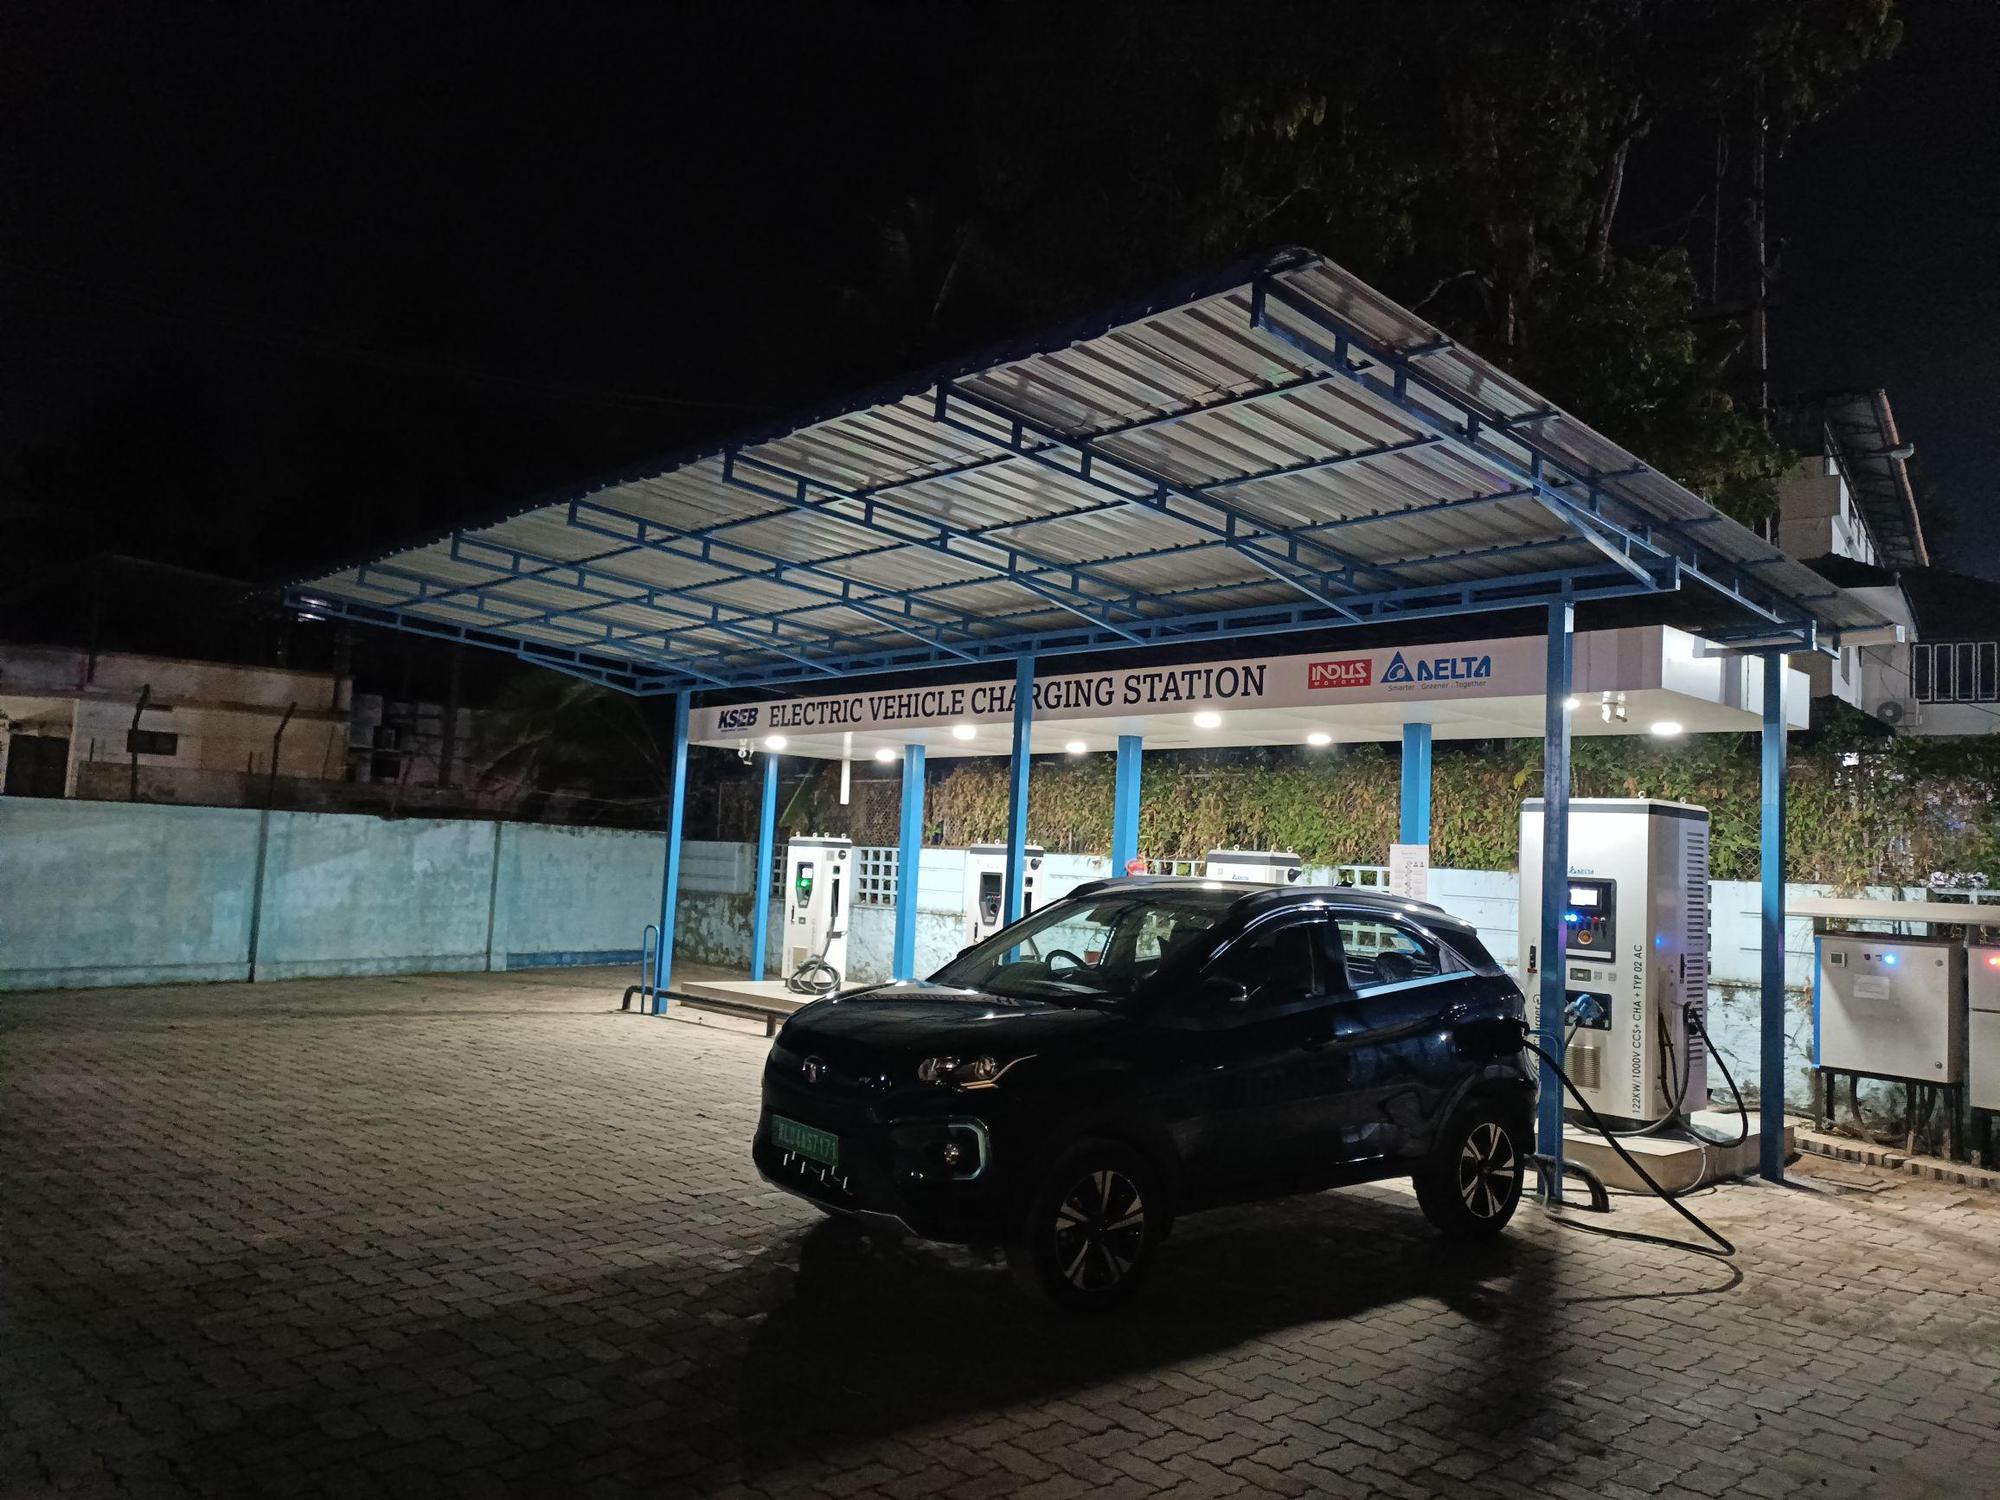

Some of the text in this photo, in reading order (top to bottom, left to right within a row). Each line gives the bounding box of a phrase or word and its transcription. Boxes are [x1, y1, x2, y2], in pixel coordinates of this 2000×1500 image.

[1311, 662, 1367, 680] INDUS
[1417, 655, 1491, 681] DELTA
[718, 707, 759, 729] KSEB
[768, 698, 863, 728] ELECTRIC
[869, 690, 965, 721] VEHICLE
[1123, 665, 1266, 705] STATION
[1634, 944, 1643, 959] AC
[1633, 975, 1642, 989] TYP
[1633, 1001, 1642, 1021] CHA
